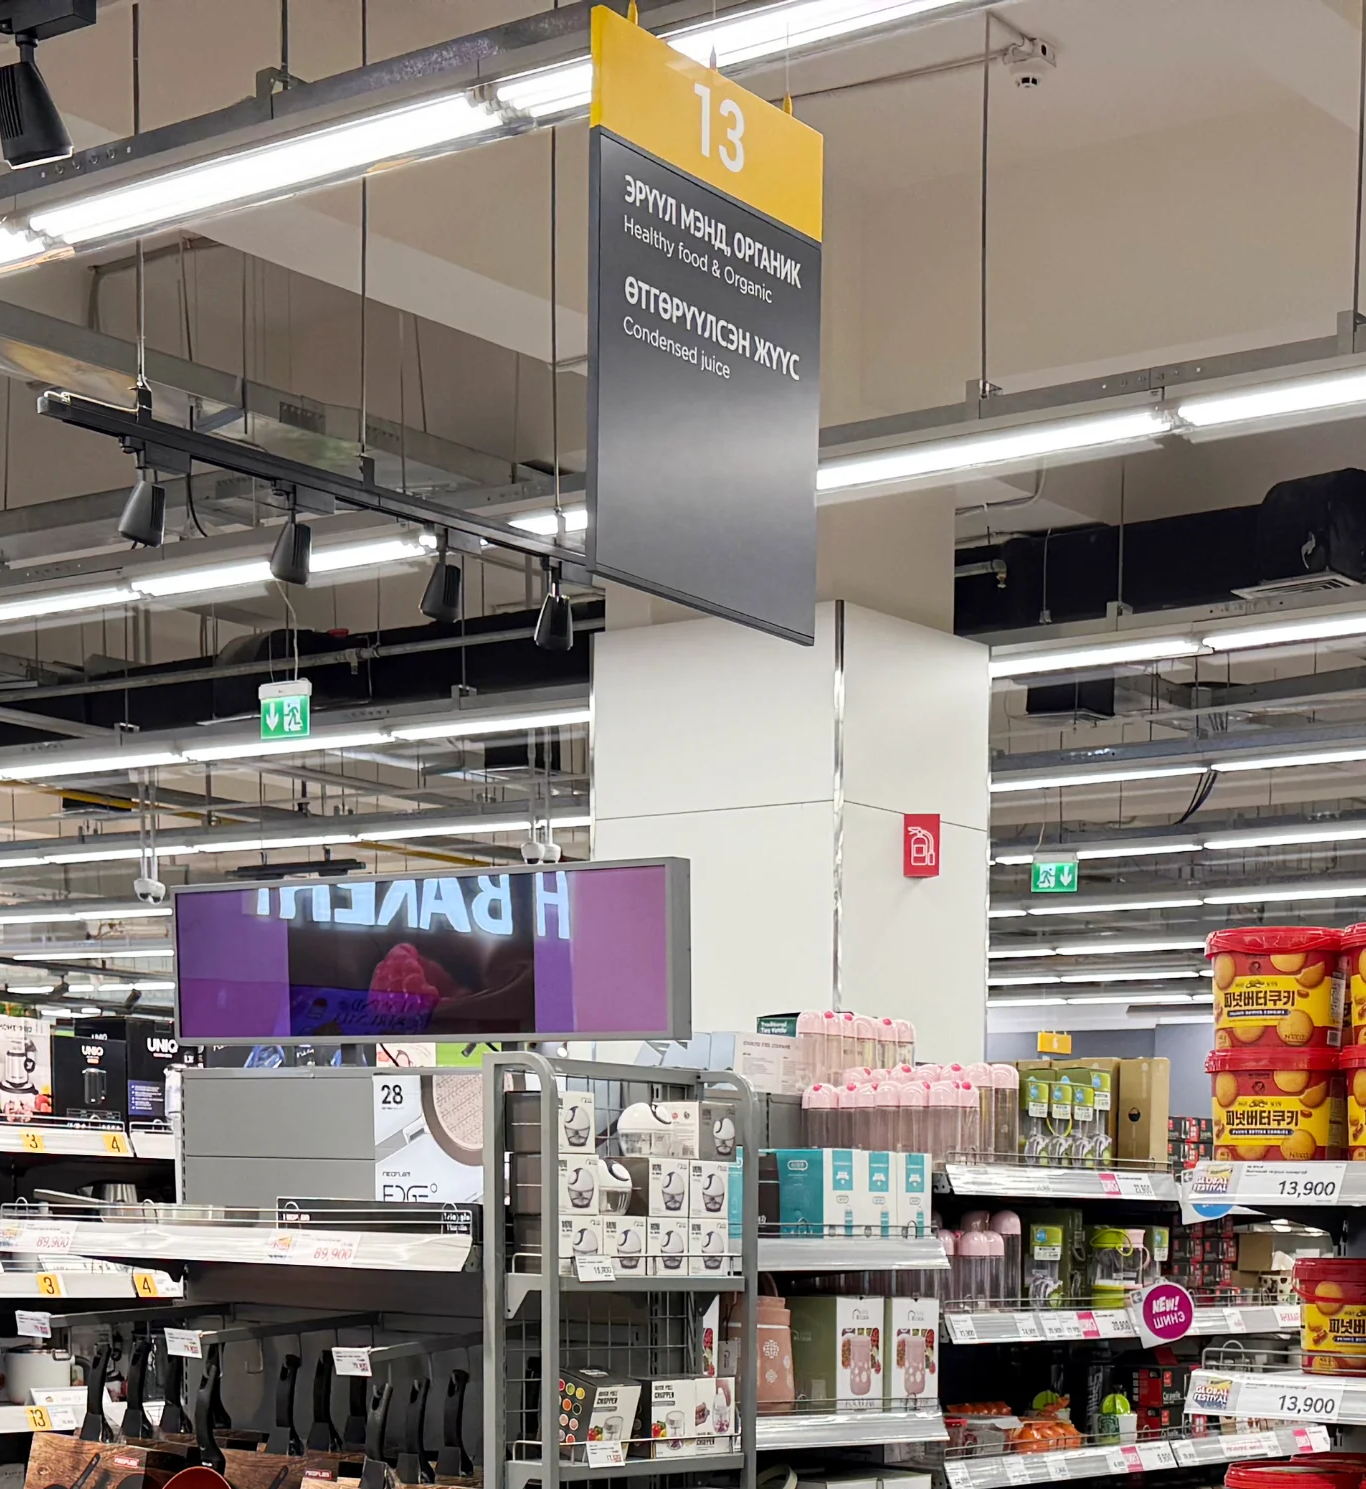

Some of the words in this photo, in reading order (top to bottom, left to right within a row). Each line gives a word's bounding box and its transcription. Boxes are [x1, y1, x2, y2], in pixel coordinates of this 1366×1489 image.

[694, 82, 745, 173] 13
[624, 174, 677, 225] ЭРҮҮЛ
[680, 206, 733, 257] МЭНД,
[734, 239, 802, 289] ОРГАНИК
[624, 215, 675, 260] Healthy
[678, 242, 709, 274] food
[711, 261, 721, 279] &
[724, 266, 773, 304] Organic
[624, 277, 752, 359] ӨТГӨРҮҮЛСЭН
[754, 341, 801, 382] ЖҮҮС
[623, 316, 698, 367] Condensed
[700, 348, 731, 379] juice
[1223, 989, 1296, 1008] 피넛버터쿠키
[147, 1038, 179, 1053] UNIQ
[381, 1084, 404, 1105] 28
[1225, 1109, 1299, 1128] 피넛버터쿠키
[1278, 1181, 1335, 1197] 13,900
[43, 1277, 55, 1294] 3
[142, 1277, 152, 1294] 4
[1152, 1296, 1180, 1314] NEW!
[1153, 1311, 1186, 1329] ШИНЭ
[1277, 1393, 1336, 1415] 13,900
[33, 1409, 45, 1427] 13
